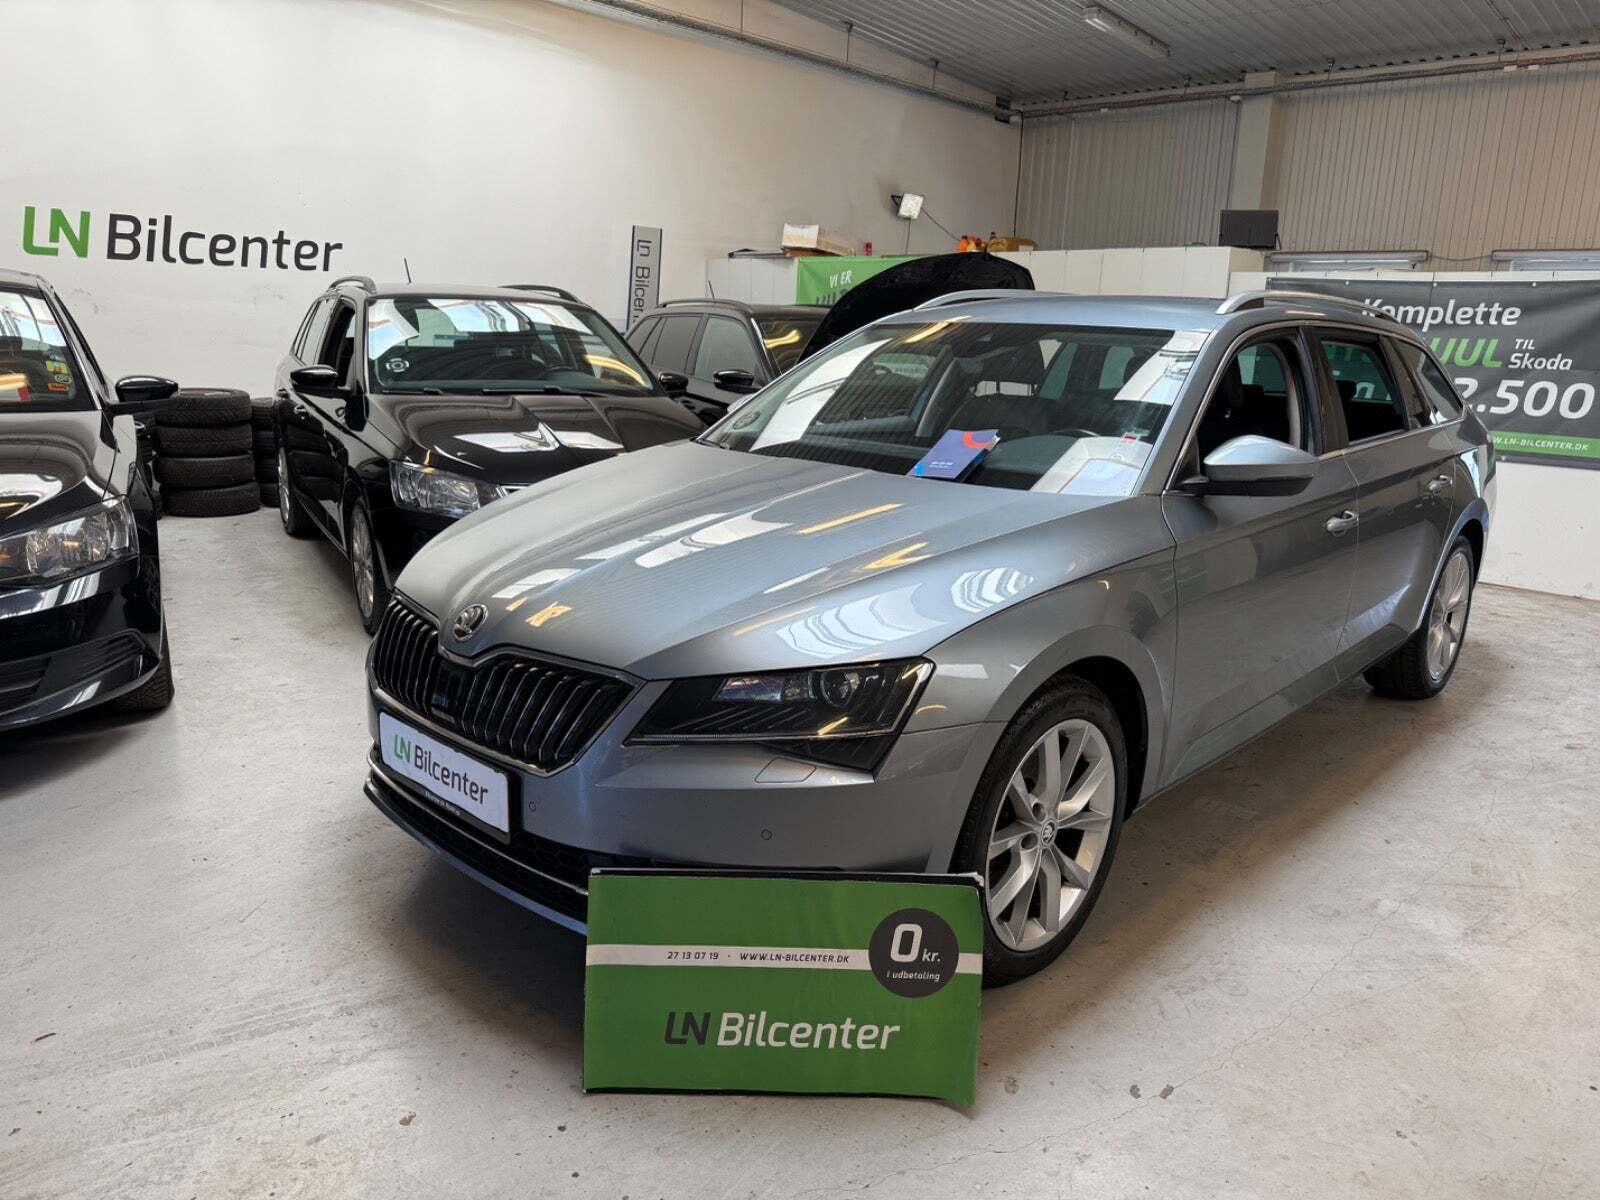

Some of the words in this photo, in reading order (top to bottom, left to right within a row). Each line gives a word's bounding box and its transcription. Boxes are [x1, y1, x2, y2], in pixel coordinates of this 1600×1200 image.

[22, 206, 90, 258] LN
[106, 213, 343, 272] Bilcenter
[841, 270, 851, 284] ER
[1514, 338, 1536, 350] TIL
[1507, 352, 1573, 371] Skoda
[393, 734, 411, 764] LN
[414, 744, 488, 805] Bilcenter
[890, 923, 923, 962] 0
[921, 948, 941, 962] kr.
[667, 951, 679, 960] 27
[682, 951, 691, 960] 13
[694, 951, 706, 960] 07
[709, 951, 719, 960] 19
[740, 952, 850, 964] WWW.LN-BILCENTER.DK
[892, 970, 940, 982] udbetaling
[664, 1011, 712, 1045] LN
[716, 1010, 901, 1050] Bilcenter
